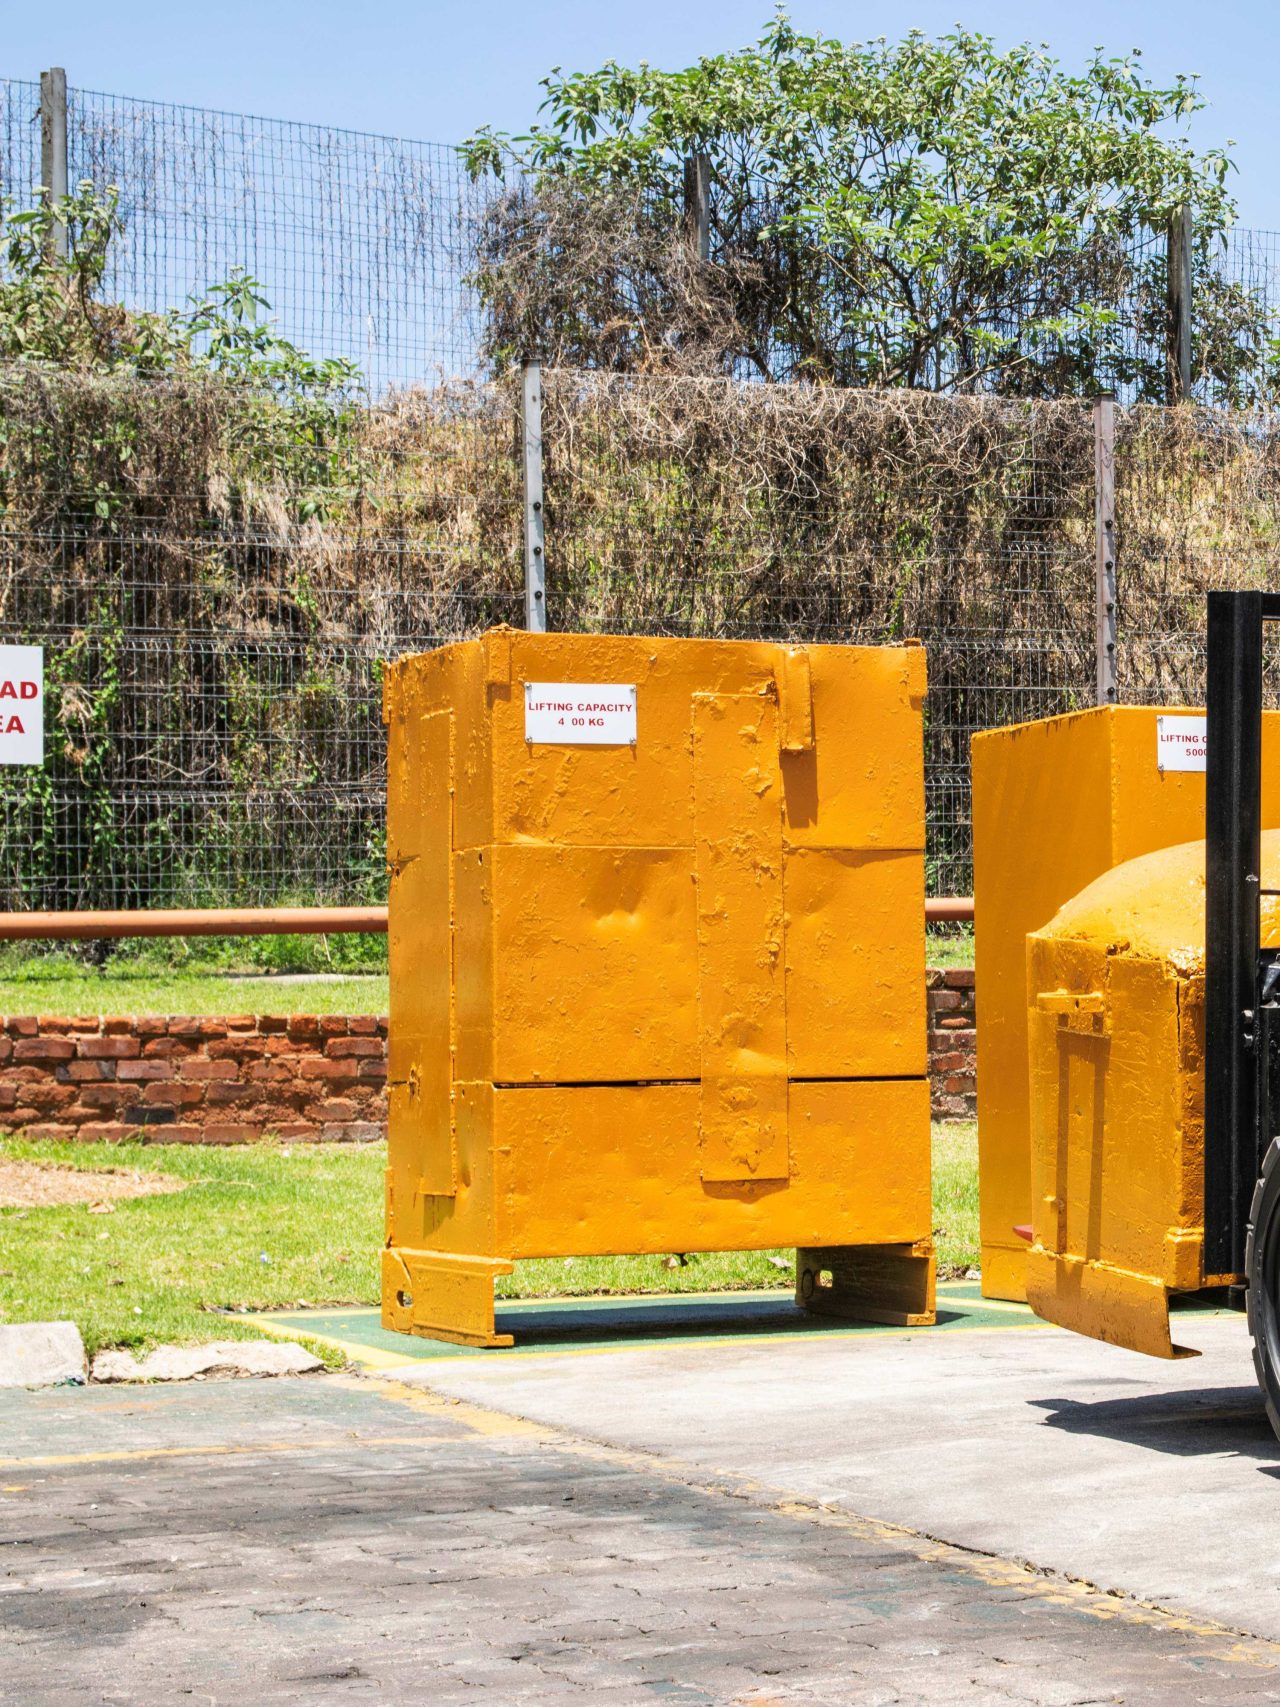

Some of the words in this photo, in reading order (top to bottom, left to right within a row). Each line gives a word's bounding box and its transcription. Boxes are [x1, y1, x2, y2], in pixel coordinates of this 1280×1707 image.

[0, 680, 39, 700] AD
[528, 702, 573, 711] LIFTING
[577, 703, 632, 712] CAPACITY
[588, 718, 605, 726] KG
[1160, 734, 1199, 743] LIFTING
